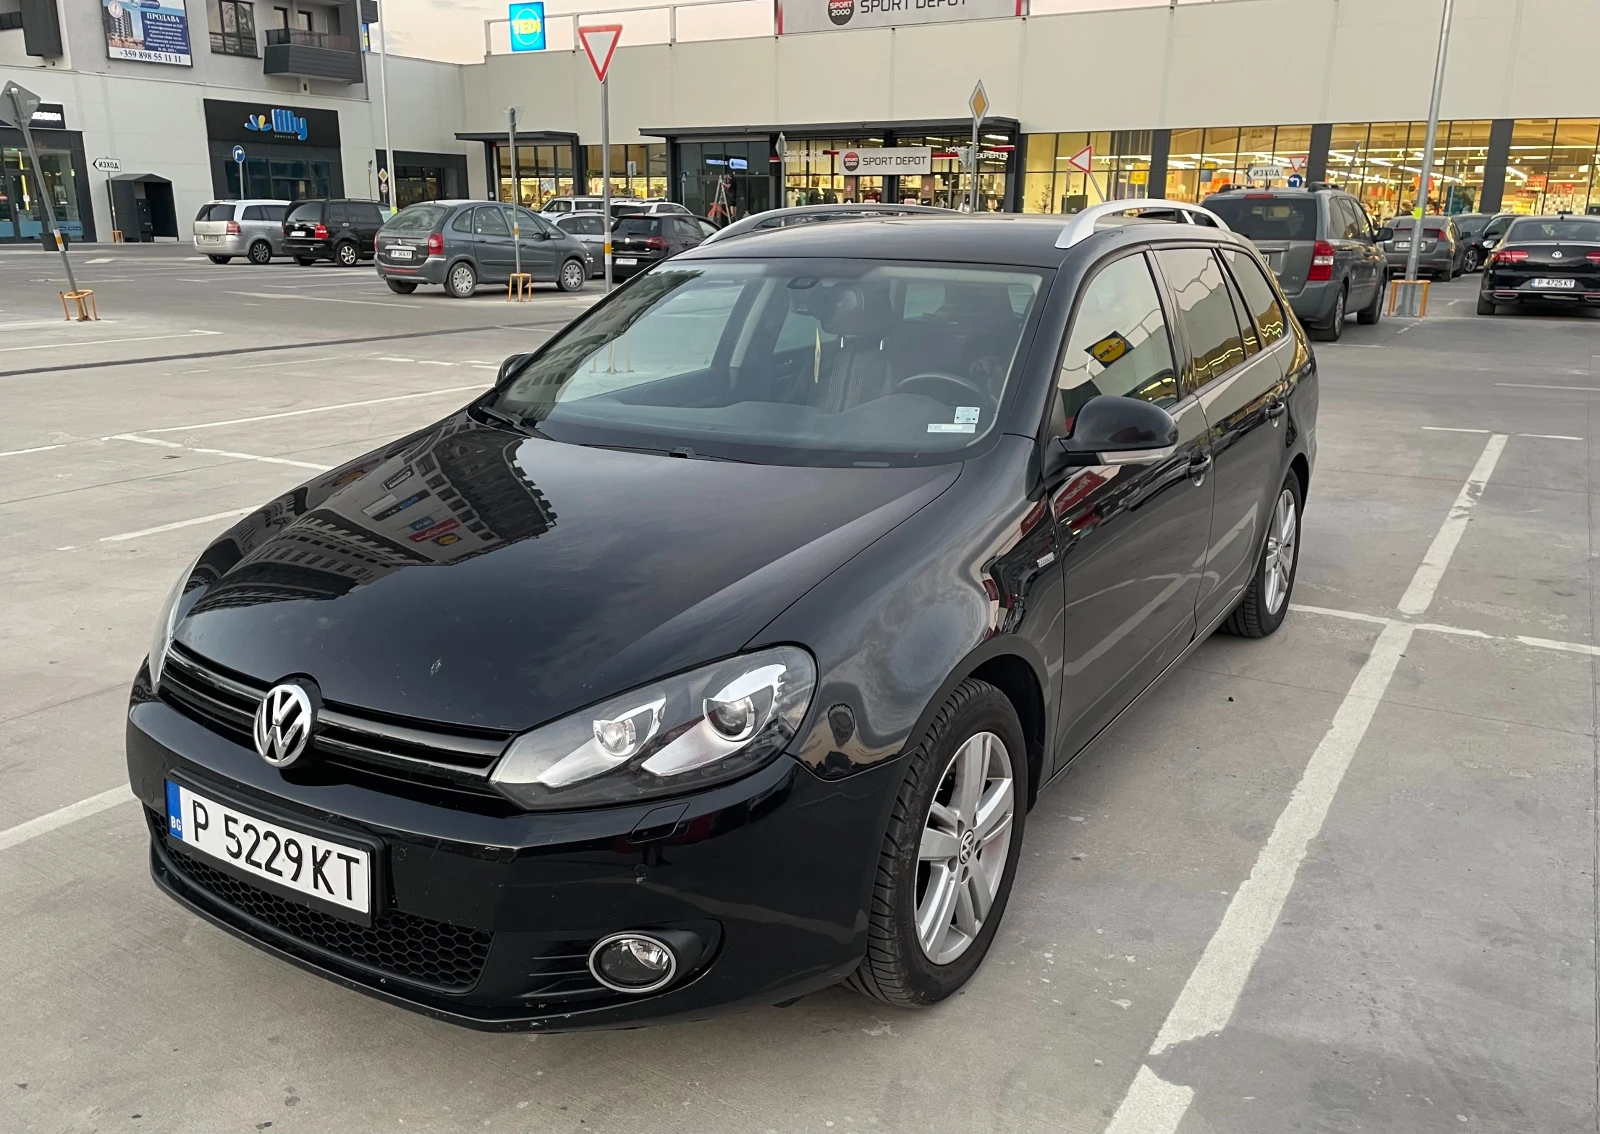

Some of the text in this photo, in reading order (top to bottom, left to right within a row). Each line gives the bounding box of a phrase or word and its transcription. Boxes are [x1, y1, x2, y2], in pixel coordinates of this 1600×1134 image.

[829, 1, 852, 9] SPORT
[860, 0, 909, 13] SPORT
[146, 12, 180, 23] ПРОДАВА
[120, 49, 182, 63] +359 898 55 11 11
[271, 108, 308, 141] lilly
[98, 161, 119, 169] ИЗХОД
[862, 156, 927, 166] SPORT DEPOT
[1253, 169, 1280, 177] ИЗХОД
[171, 815, 182, 831] BG
[193, 799, 360, 901] P 5229 KT
